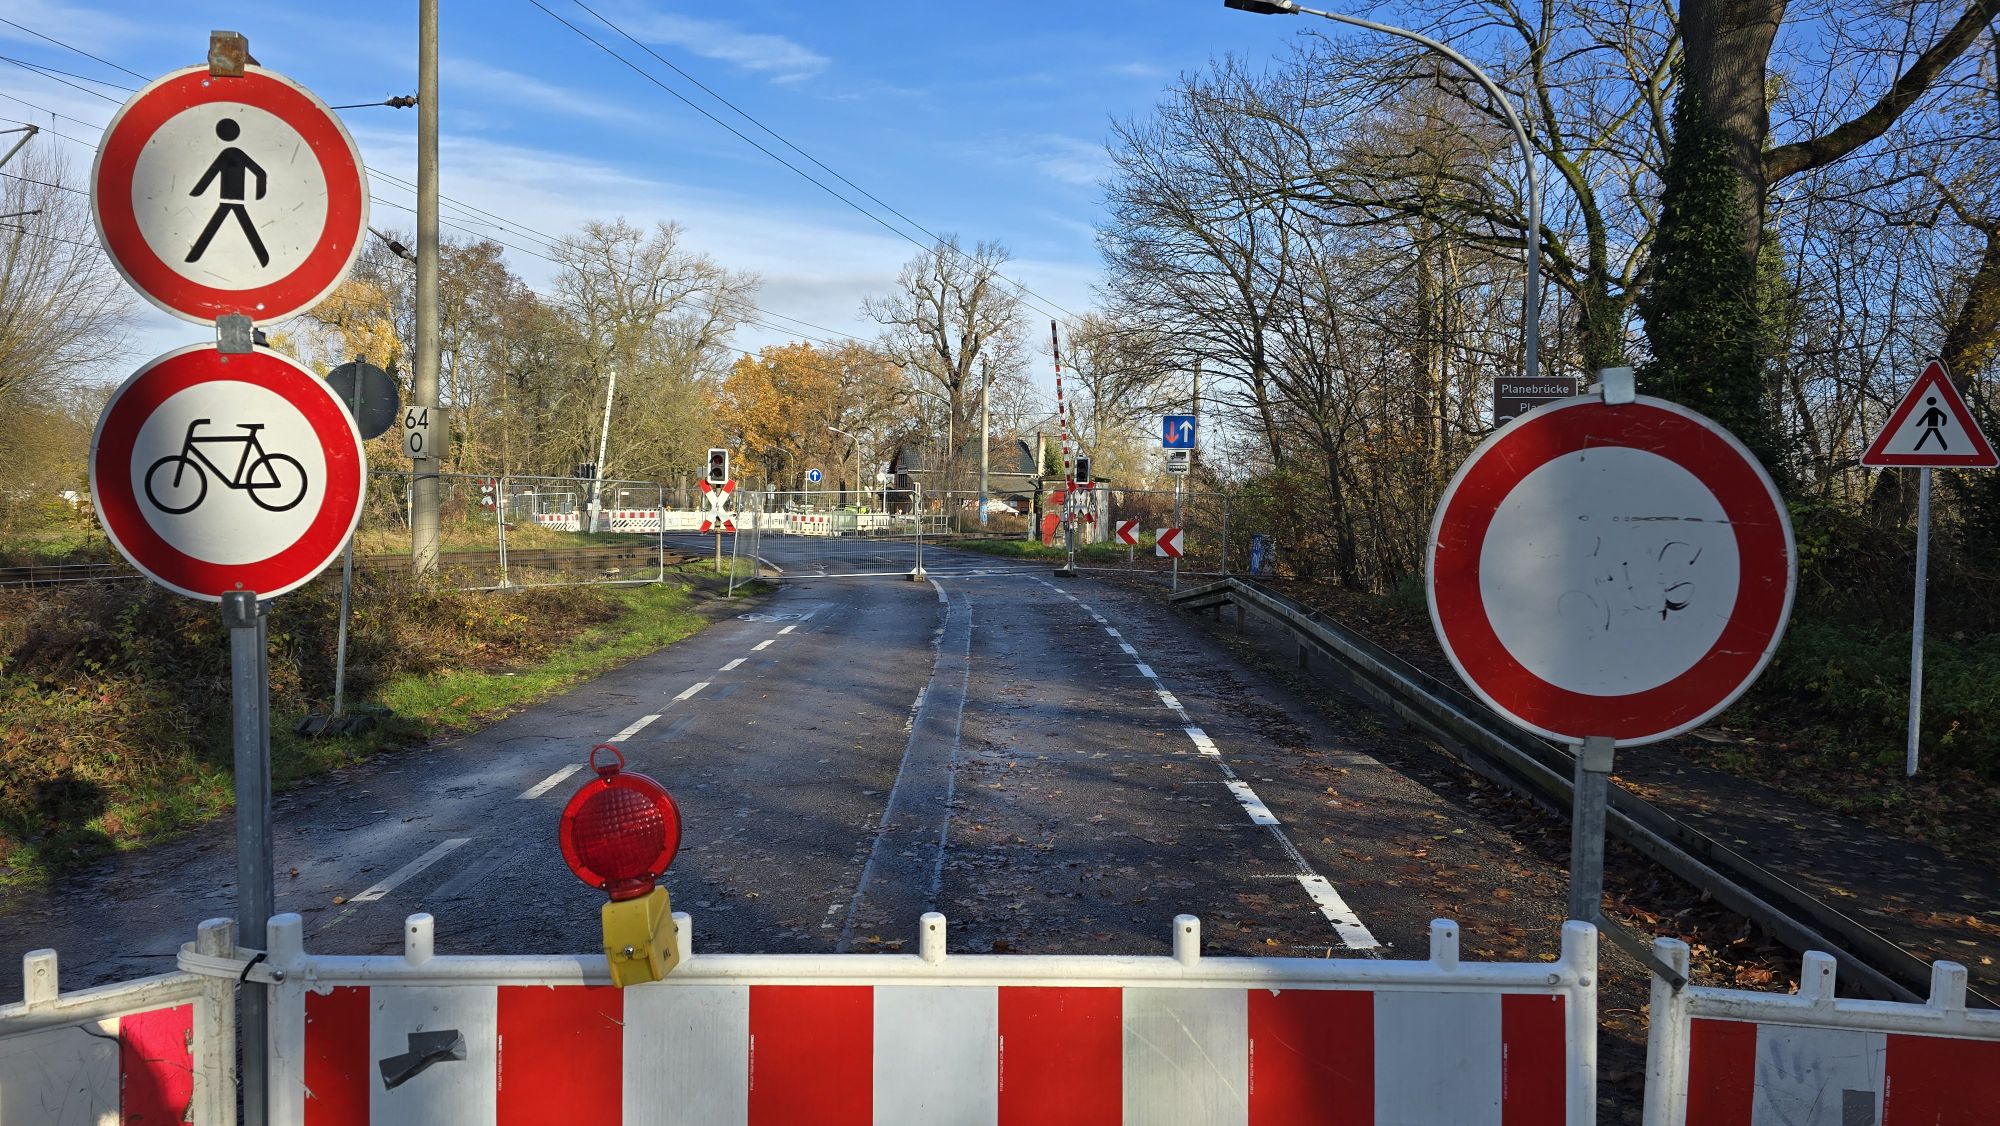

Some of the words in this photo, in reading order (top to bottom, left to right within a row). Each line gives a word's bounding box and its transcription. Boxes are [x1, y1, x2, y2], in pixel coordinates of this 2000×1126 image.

[1501, 384, 1569, 394] Planebrücke
[405, 408, 429, 430] 64
[410, 432, 423, 453] 0
